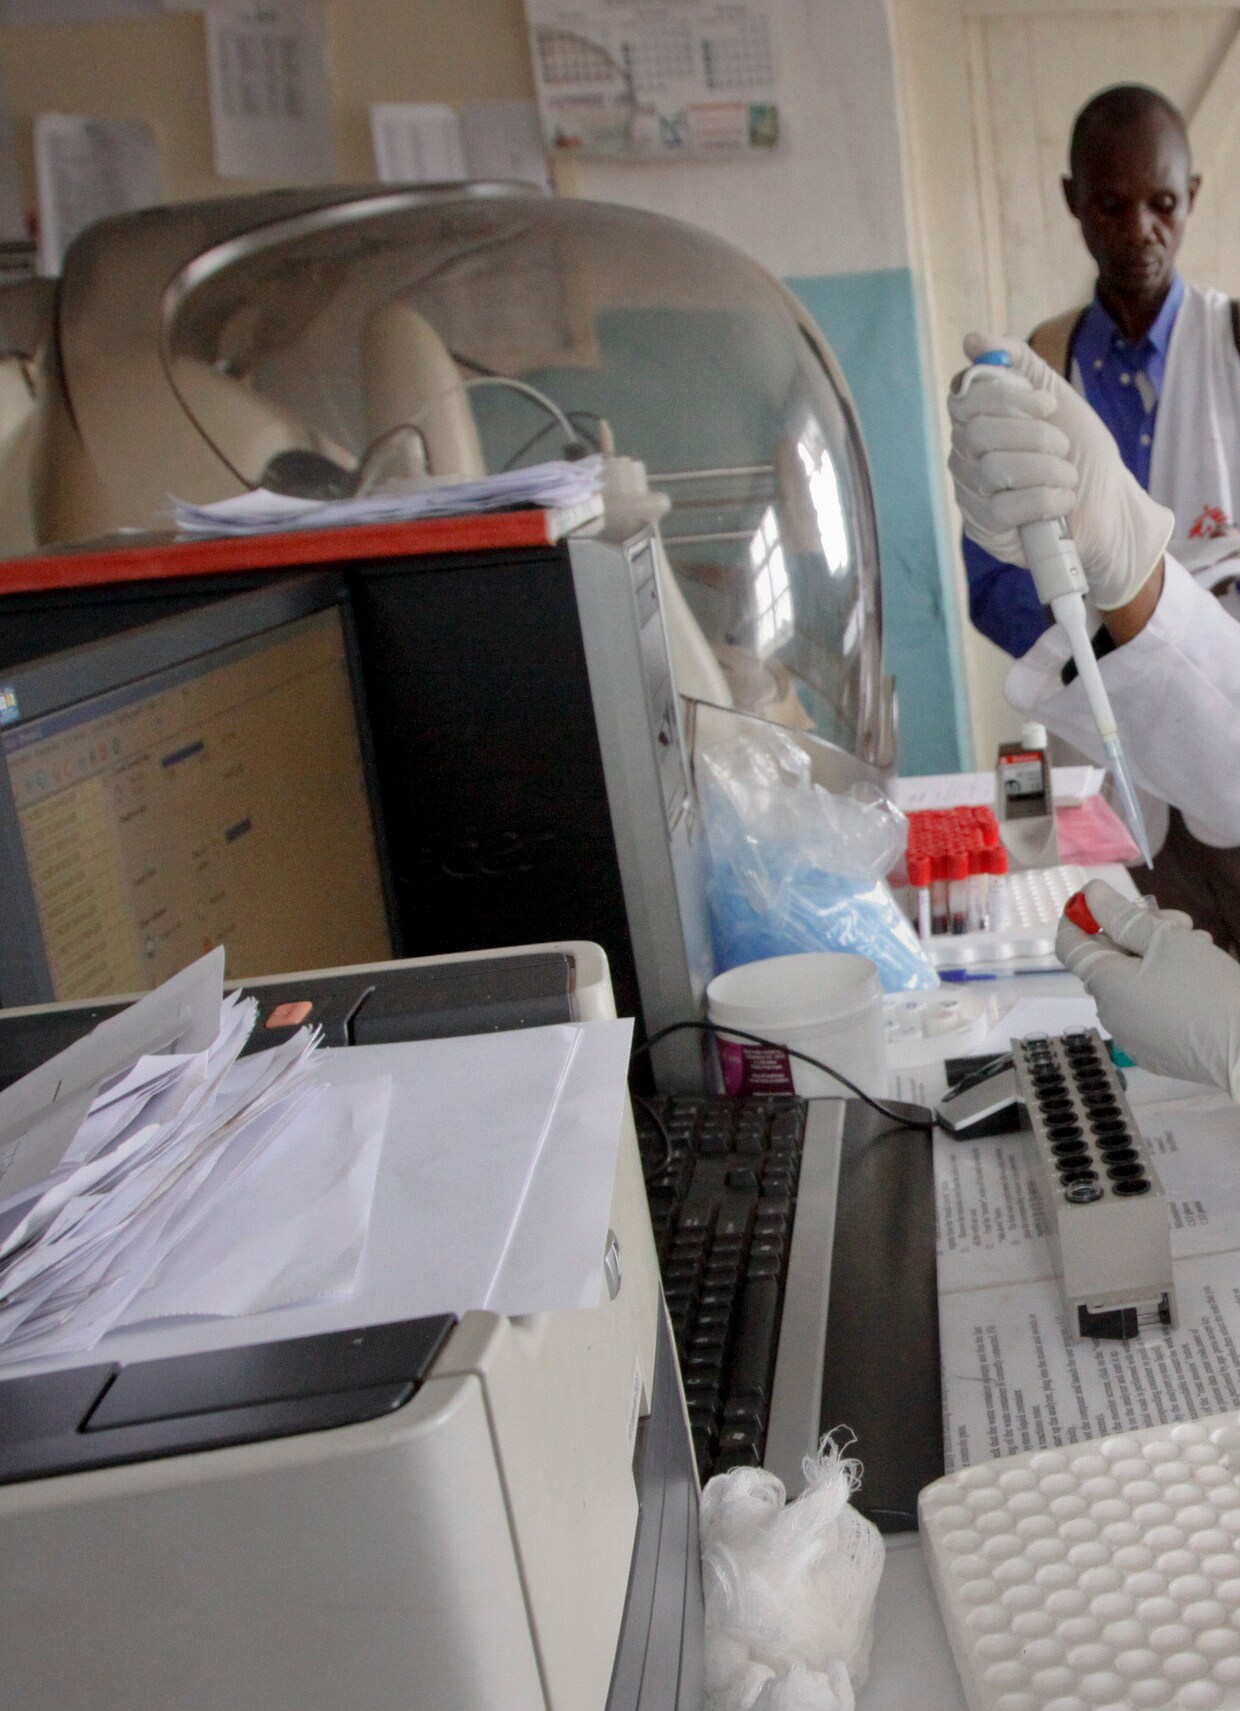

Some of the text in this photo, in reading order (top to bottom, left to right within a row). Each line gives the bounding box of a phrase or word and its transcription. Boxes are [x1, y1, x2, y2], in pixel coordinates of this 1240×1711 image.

[982, 1385, 993, 1409] container
[998, 1387, 1009, 1411] container
[1075, 1395, 1090, 1420] computer
[986, 1409, 995, 1424] waste
[1002, 1412, 1011, 1428] waste
